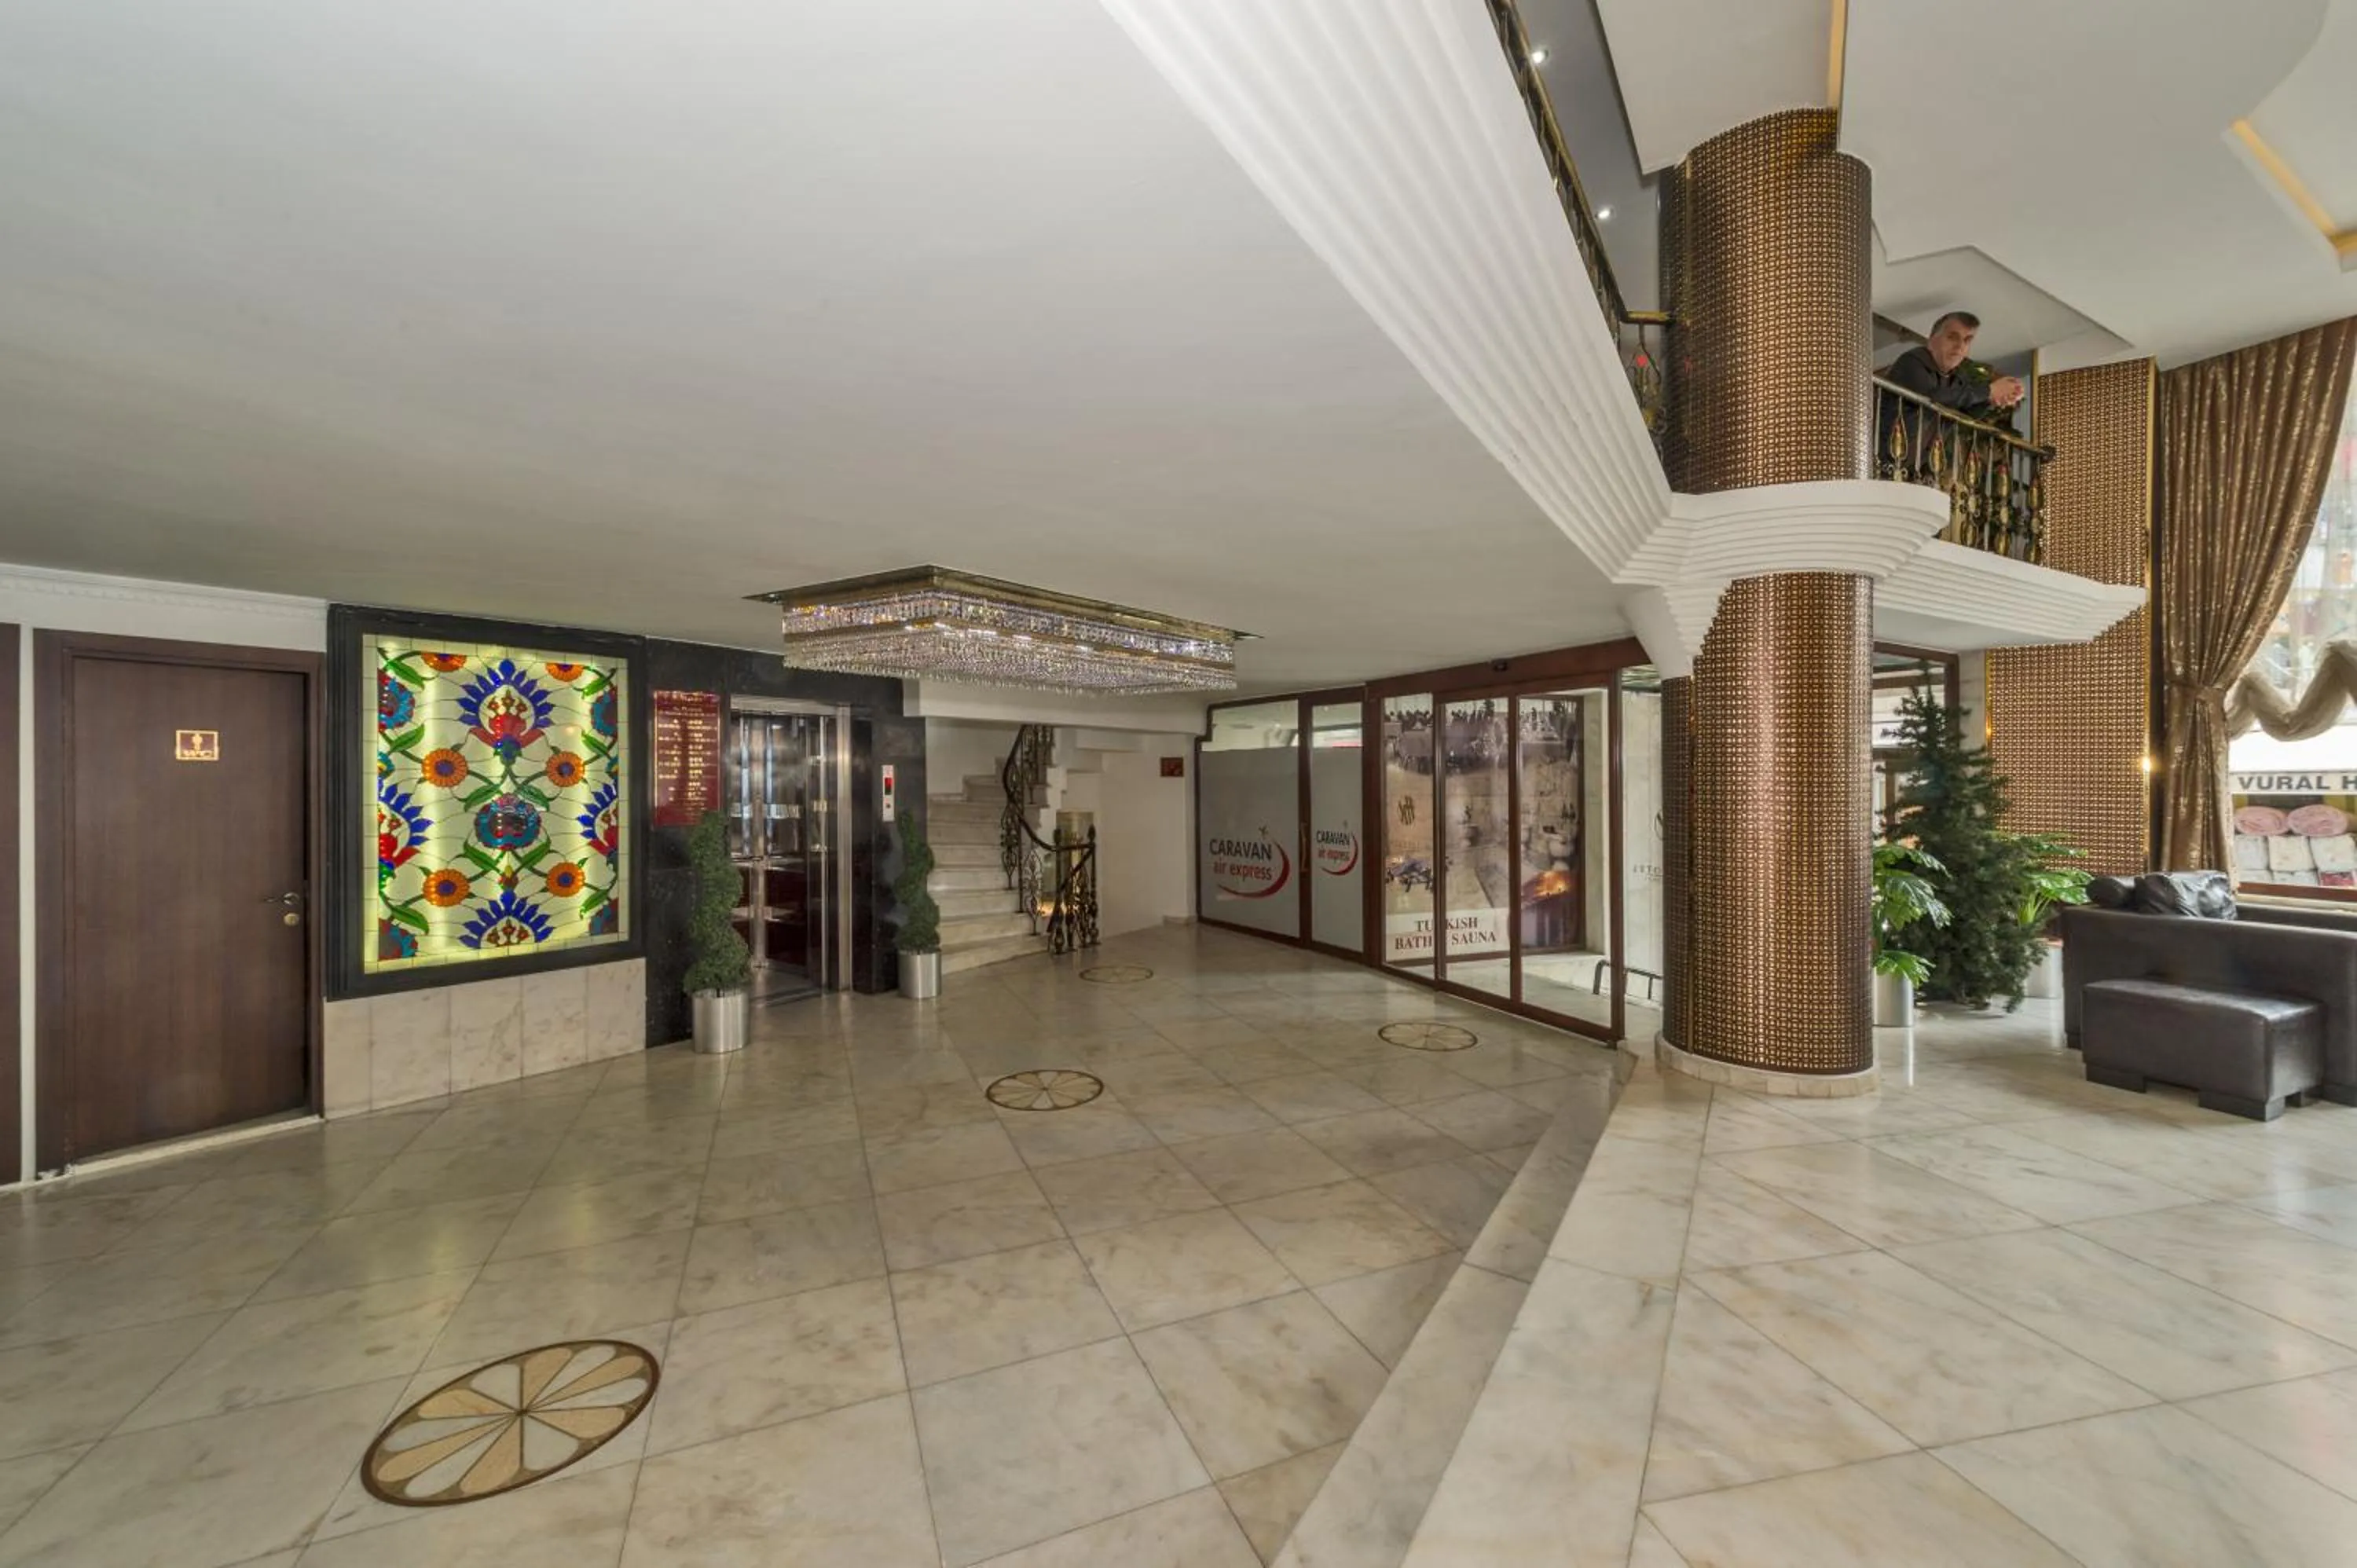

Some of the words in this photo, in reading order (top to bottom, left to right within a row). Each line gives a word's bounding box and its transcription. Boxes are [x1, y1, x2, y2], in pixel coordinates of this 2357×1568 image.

[2238, 775, 2330, 790] VURAL
[1316, 830, 1350, 846] CARAVAN
[1209, 838, 1272, 861] CARAVAN
[1212, 858, 1226, 874] air
[1230, 863, 1273, 882] express
[1415, 917, 1478, 932] TUKISH
[1395, 936, 1432, 950] BATH
[1451, 930, 1497, 945] SAUNA
